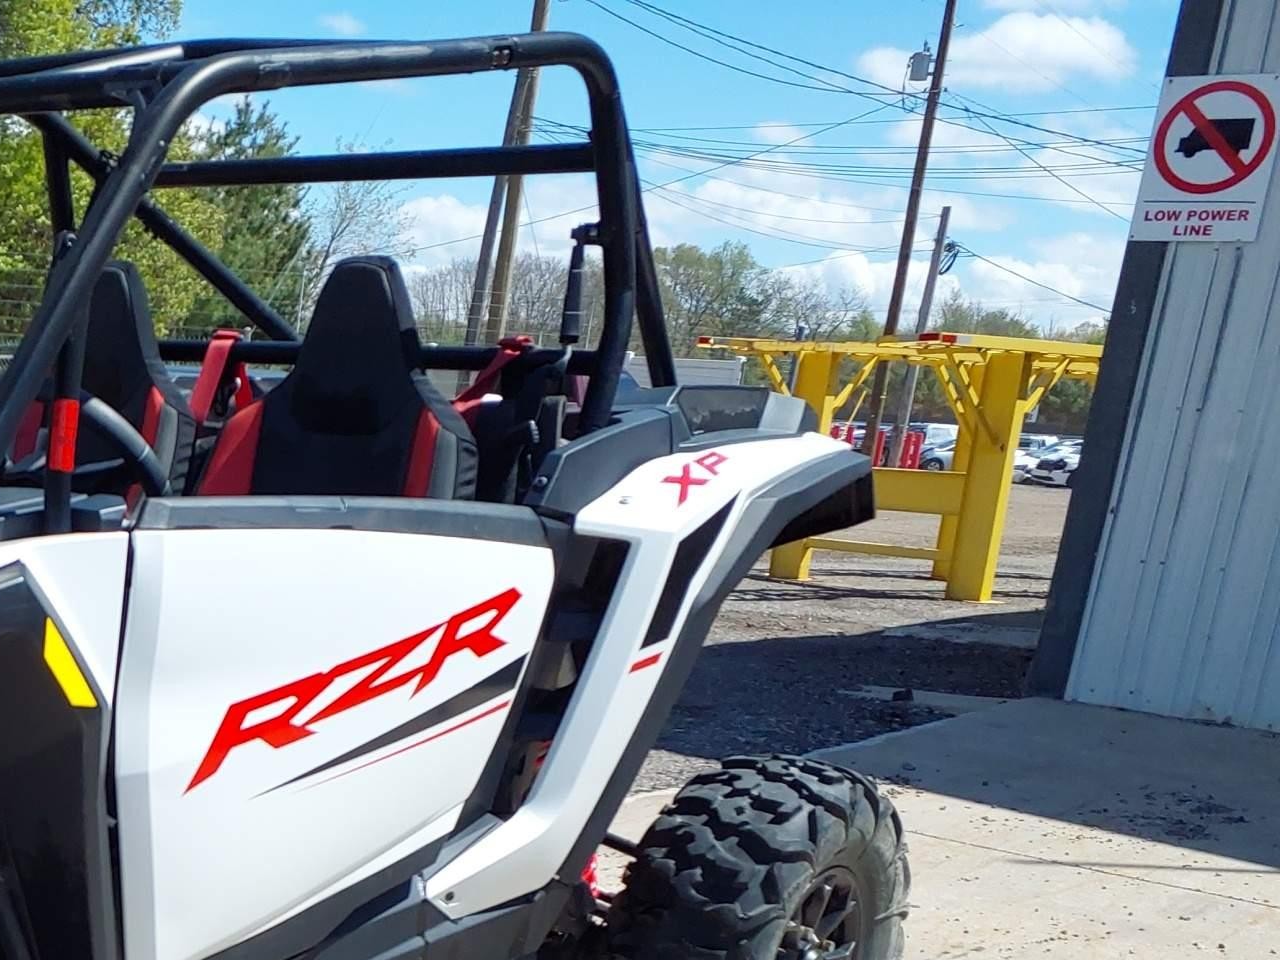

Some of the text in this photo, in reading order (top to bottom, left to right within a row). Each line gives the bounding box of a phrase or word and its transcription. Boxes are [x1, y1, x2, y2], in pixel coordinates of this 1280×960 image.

[1144, 209, 1250, 221] LOW POWER
[1173, 225, 1213, 236] LINE
[660, 450, 728, 508] XP
[182, 587, 523, 796] RZR
